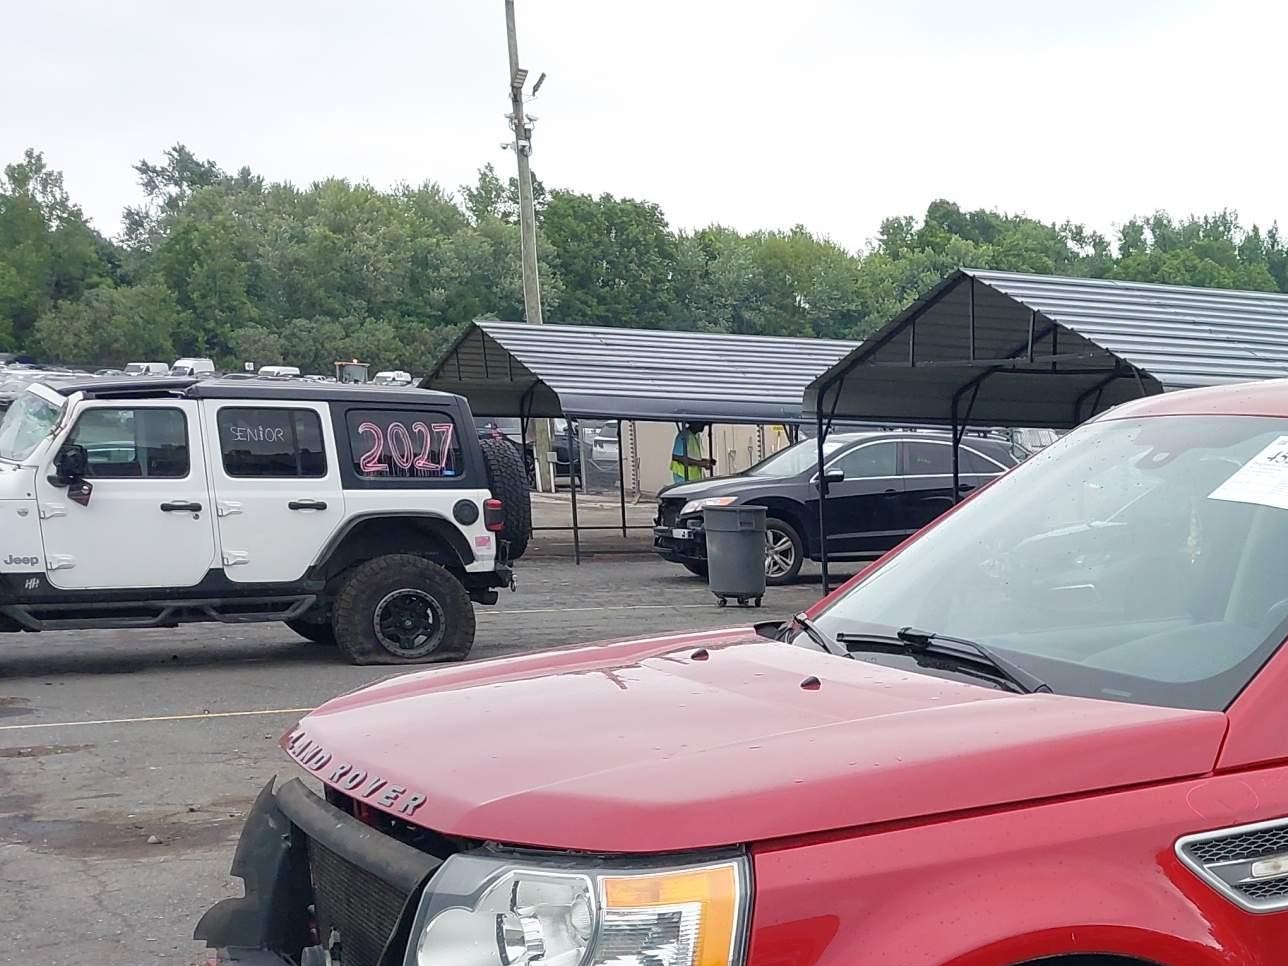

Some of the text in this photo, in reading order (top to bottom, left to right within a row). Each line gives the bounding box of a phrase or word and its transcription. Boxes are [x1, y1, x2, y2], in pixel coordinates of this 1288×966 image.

[358, 422, 454, 472] 2027
[4, 554, 39, 566] Jeep
[289, 731, 427, 817] LAND ROVER
